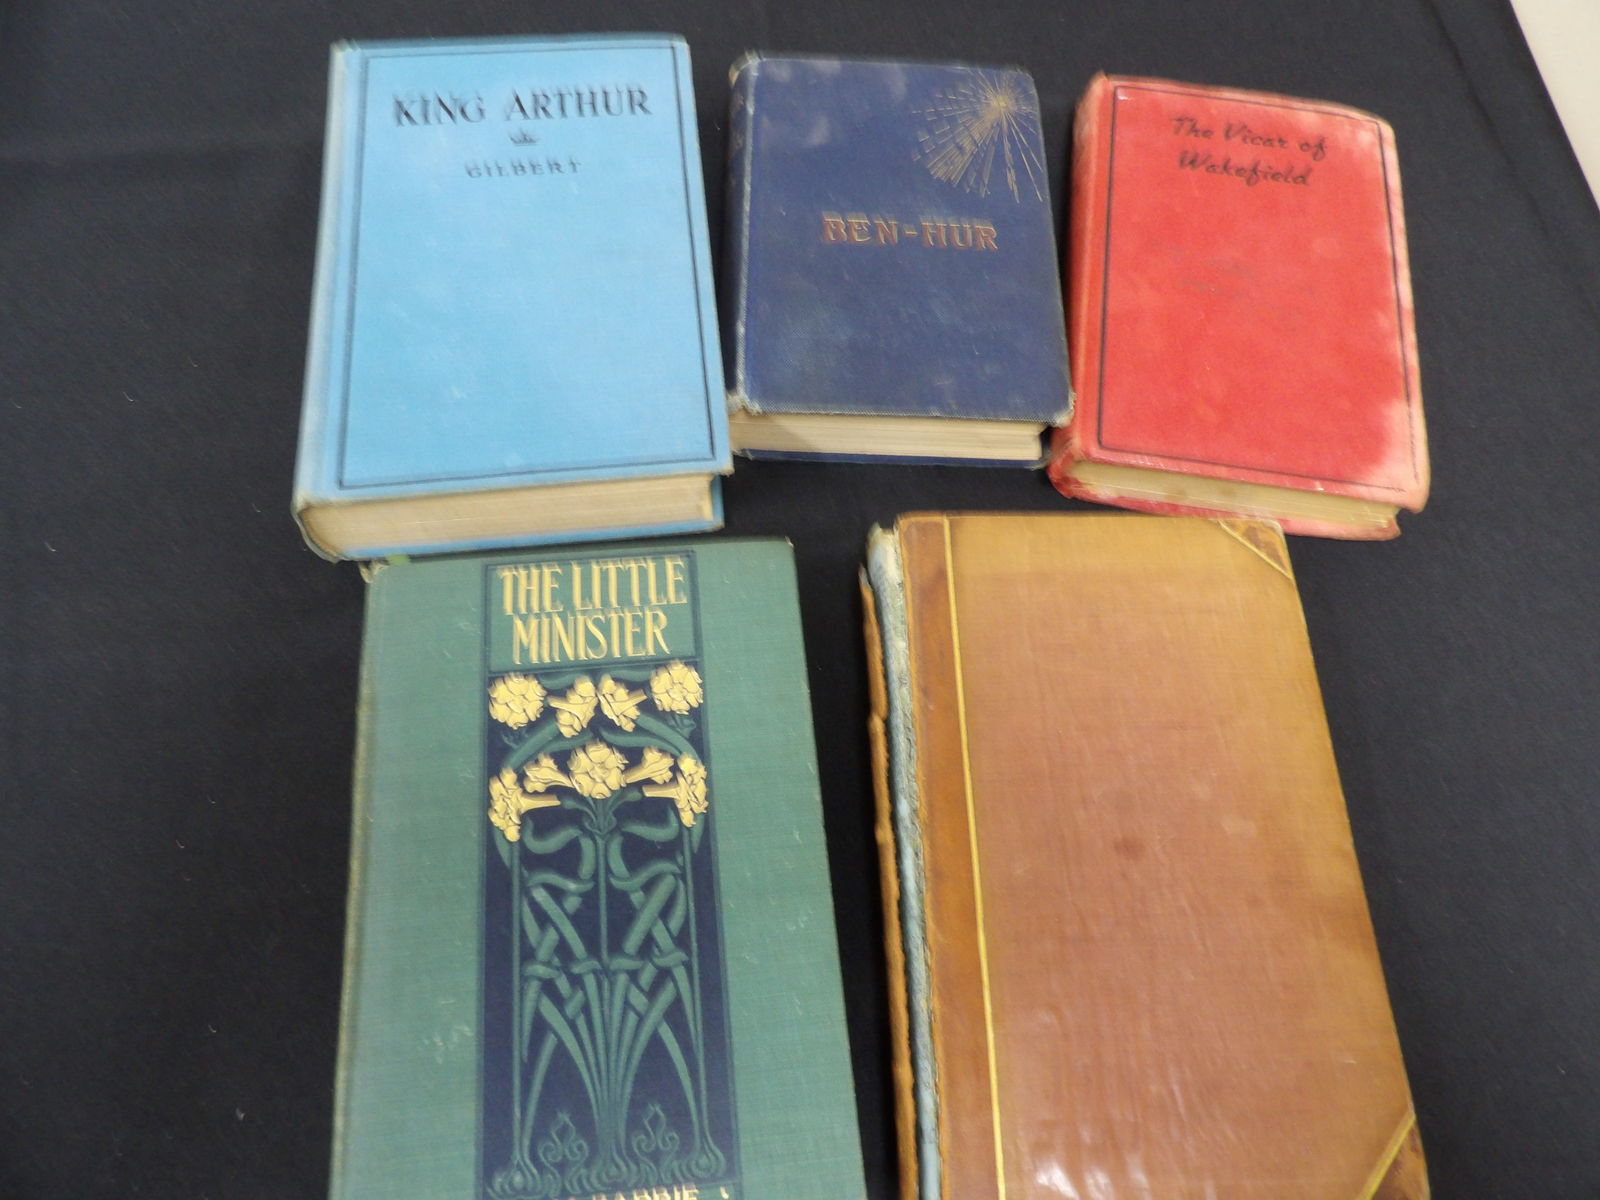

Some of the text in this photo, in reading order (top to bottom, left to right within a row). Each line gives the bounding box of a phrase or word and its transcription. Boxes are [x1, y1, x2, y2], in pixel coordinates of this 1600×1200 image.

[394, 84, 653, 127] KING ARTHUR
[1170, 116, 1328, 162] The Vicar of
[465, 155, 581, 178] GILBERT
[1178, 150, 1313, 187] Wakefield
[821, 211, 999, 252] BEN-HUR
[497, 554, 688, 616] THE LITTLE
[512, 606, 671, 665] MINISTER
